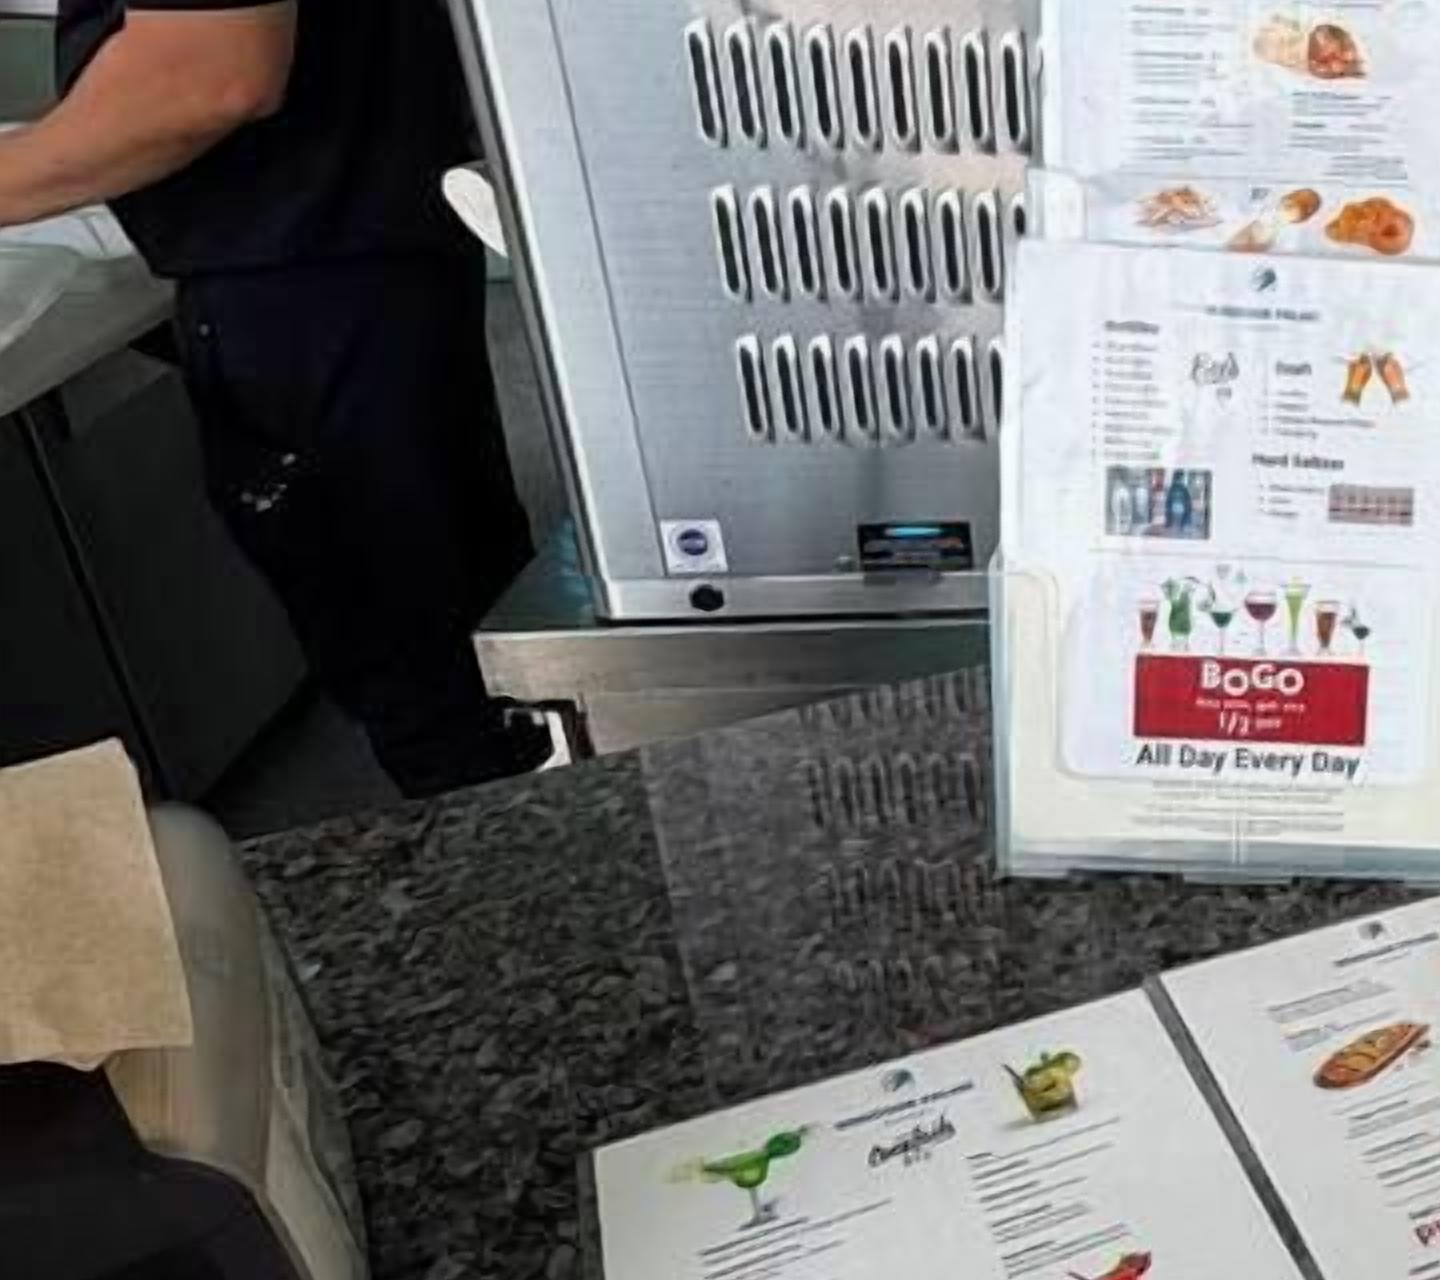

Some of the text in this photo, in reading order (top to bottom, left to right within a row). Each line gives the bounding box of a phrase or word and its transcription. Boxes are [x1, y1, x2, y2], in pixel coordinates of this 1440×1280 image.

[1136, 743, 1361, 780] All Day Every Day
